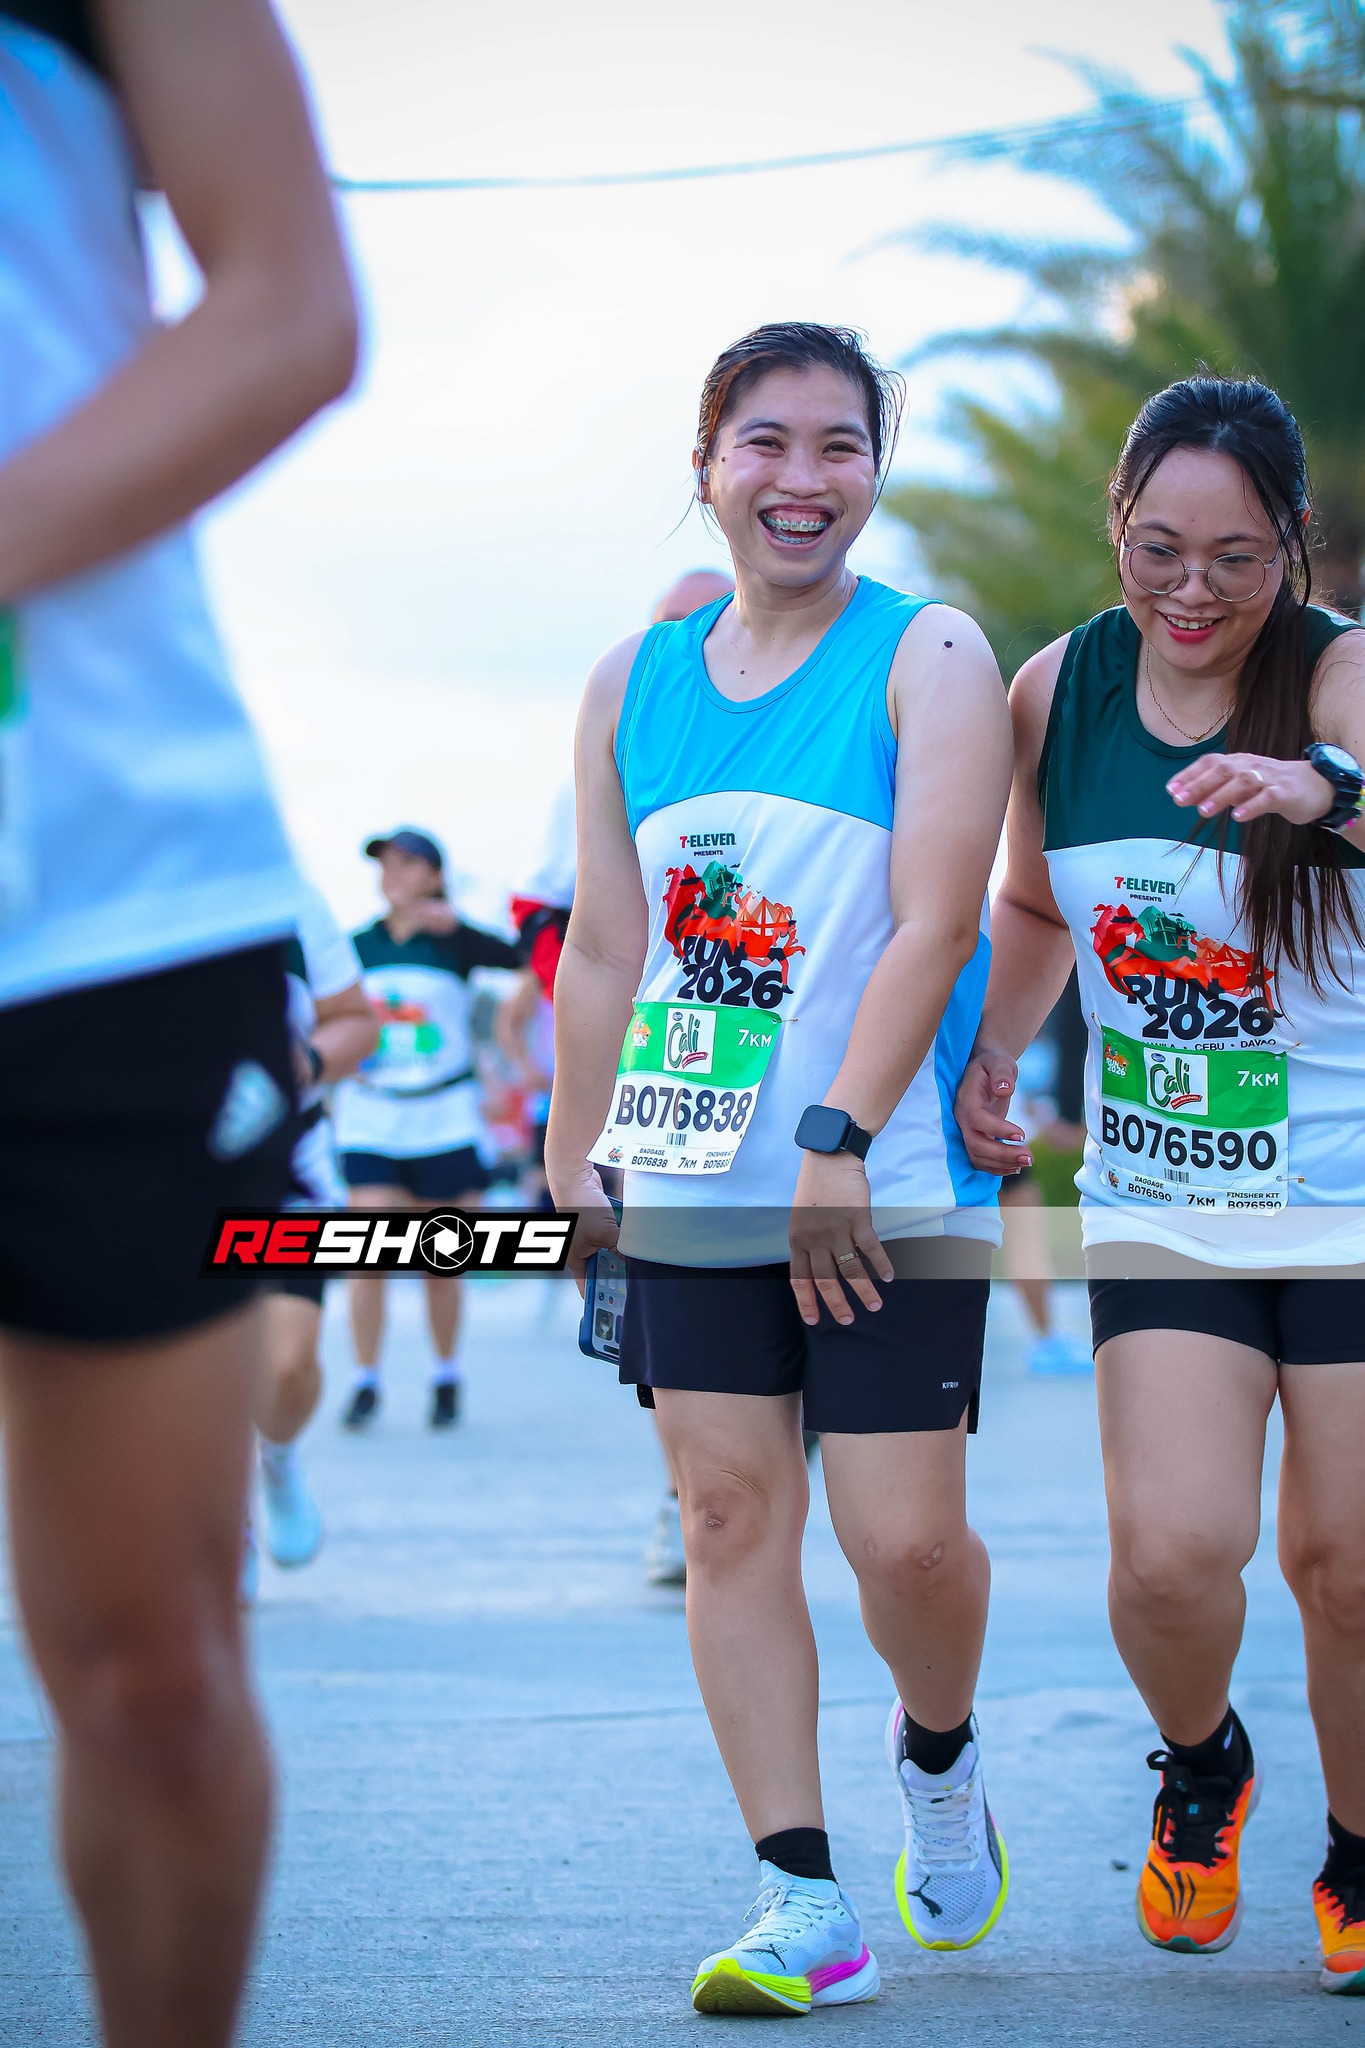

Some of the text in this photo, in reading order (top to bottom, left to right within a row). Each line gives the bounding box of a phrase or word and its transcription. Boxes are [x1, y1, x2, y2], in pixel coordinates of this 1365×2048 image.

[1129, 893, 1162, 902] PRESENTS
[677, 964, 783, 1009] 2026
[1122, 975, 1222, 1008] RUN
[1142, 997, 1274, 1041] 2026
[668, 1013, 700, 1068] Cali
[1195, 1042, 1225, 1050] CEBU
[1150, 1057, 1190, 1107] Cali
[615, 1084, 753, 1132] B076838
[1102, 1104, 1277, 1171] B076590
[631, 1155, 668, 1168] B076838
[639, 1148, 666, 1157] BAGGAGE
[1128, 1182, 1172, 1202] B076590
[1134, 1175, 1165, 1190] BAGGAGE
[1227, 1201, 1282, 1210] B076590
